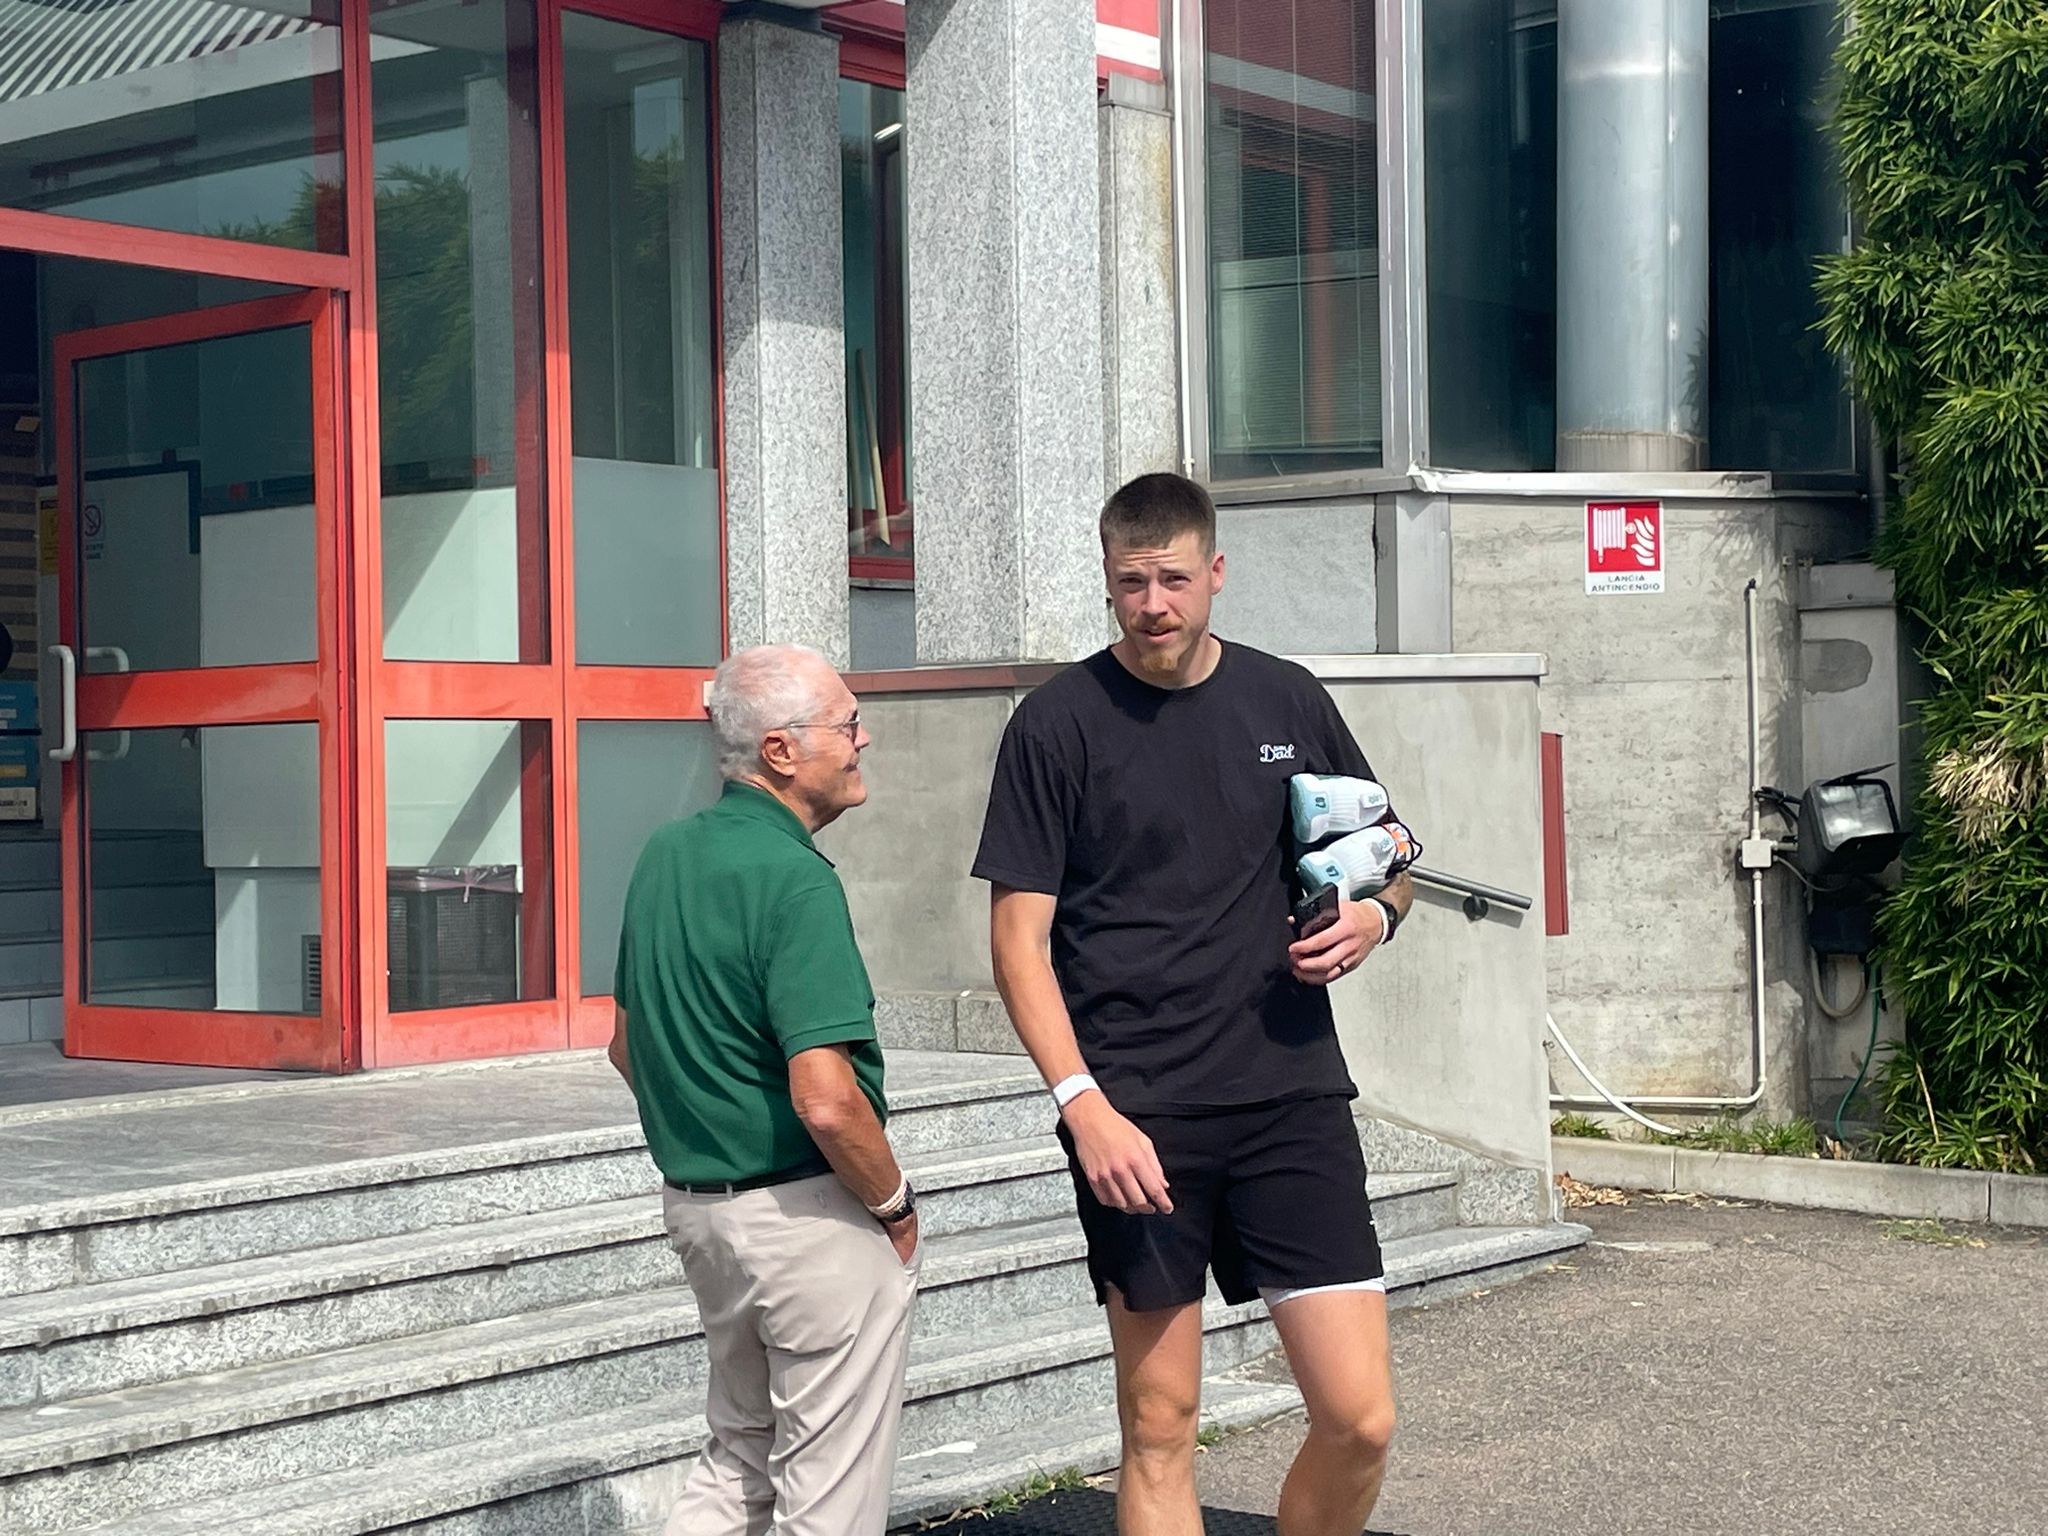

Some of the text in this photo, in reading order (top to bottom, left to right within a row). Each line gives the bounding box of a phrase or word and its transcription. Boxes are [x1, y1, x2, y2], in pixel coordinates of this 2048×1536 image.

[1608, 575, 1645, 583] LANCIA
[1592, 583, 1660, 592] ANTINCENDIO
[1260, 744, 1295, 762] Dad
